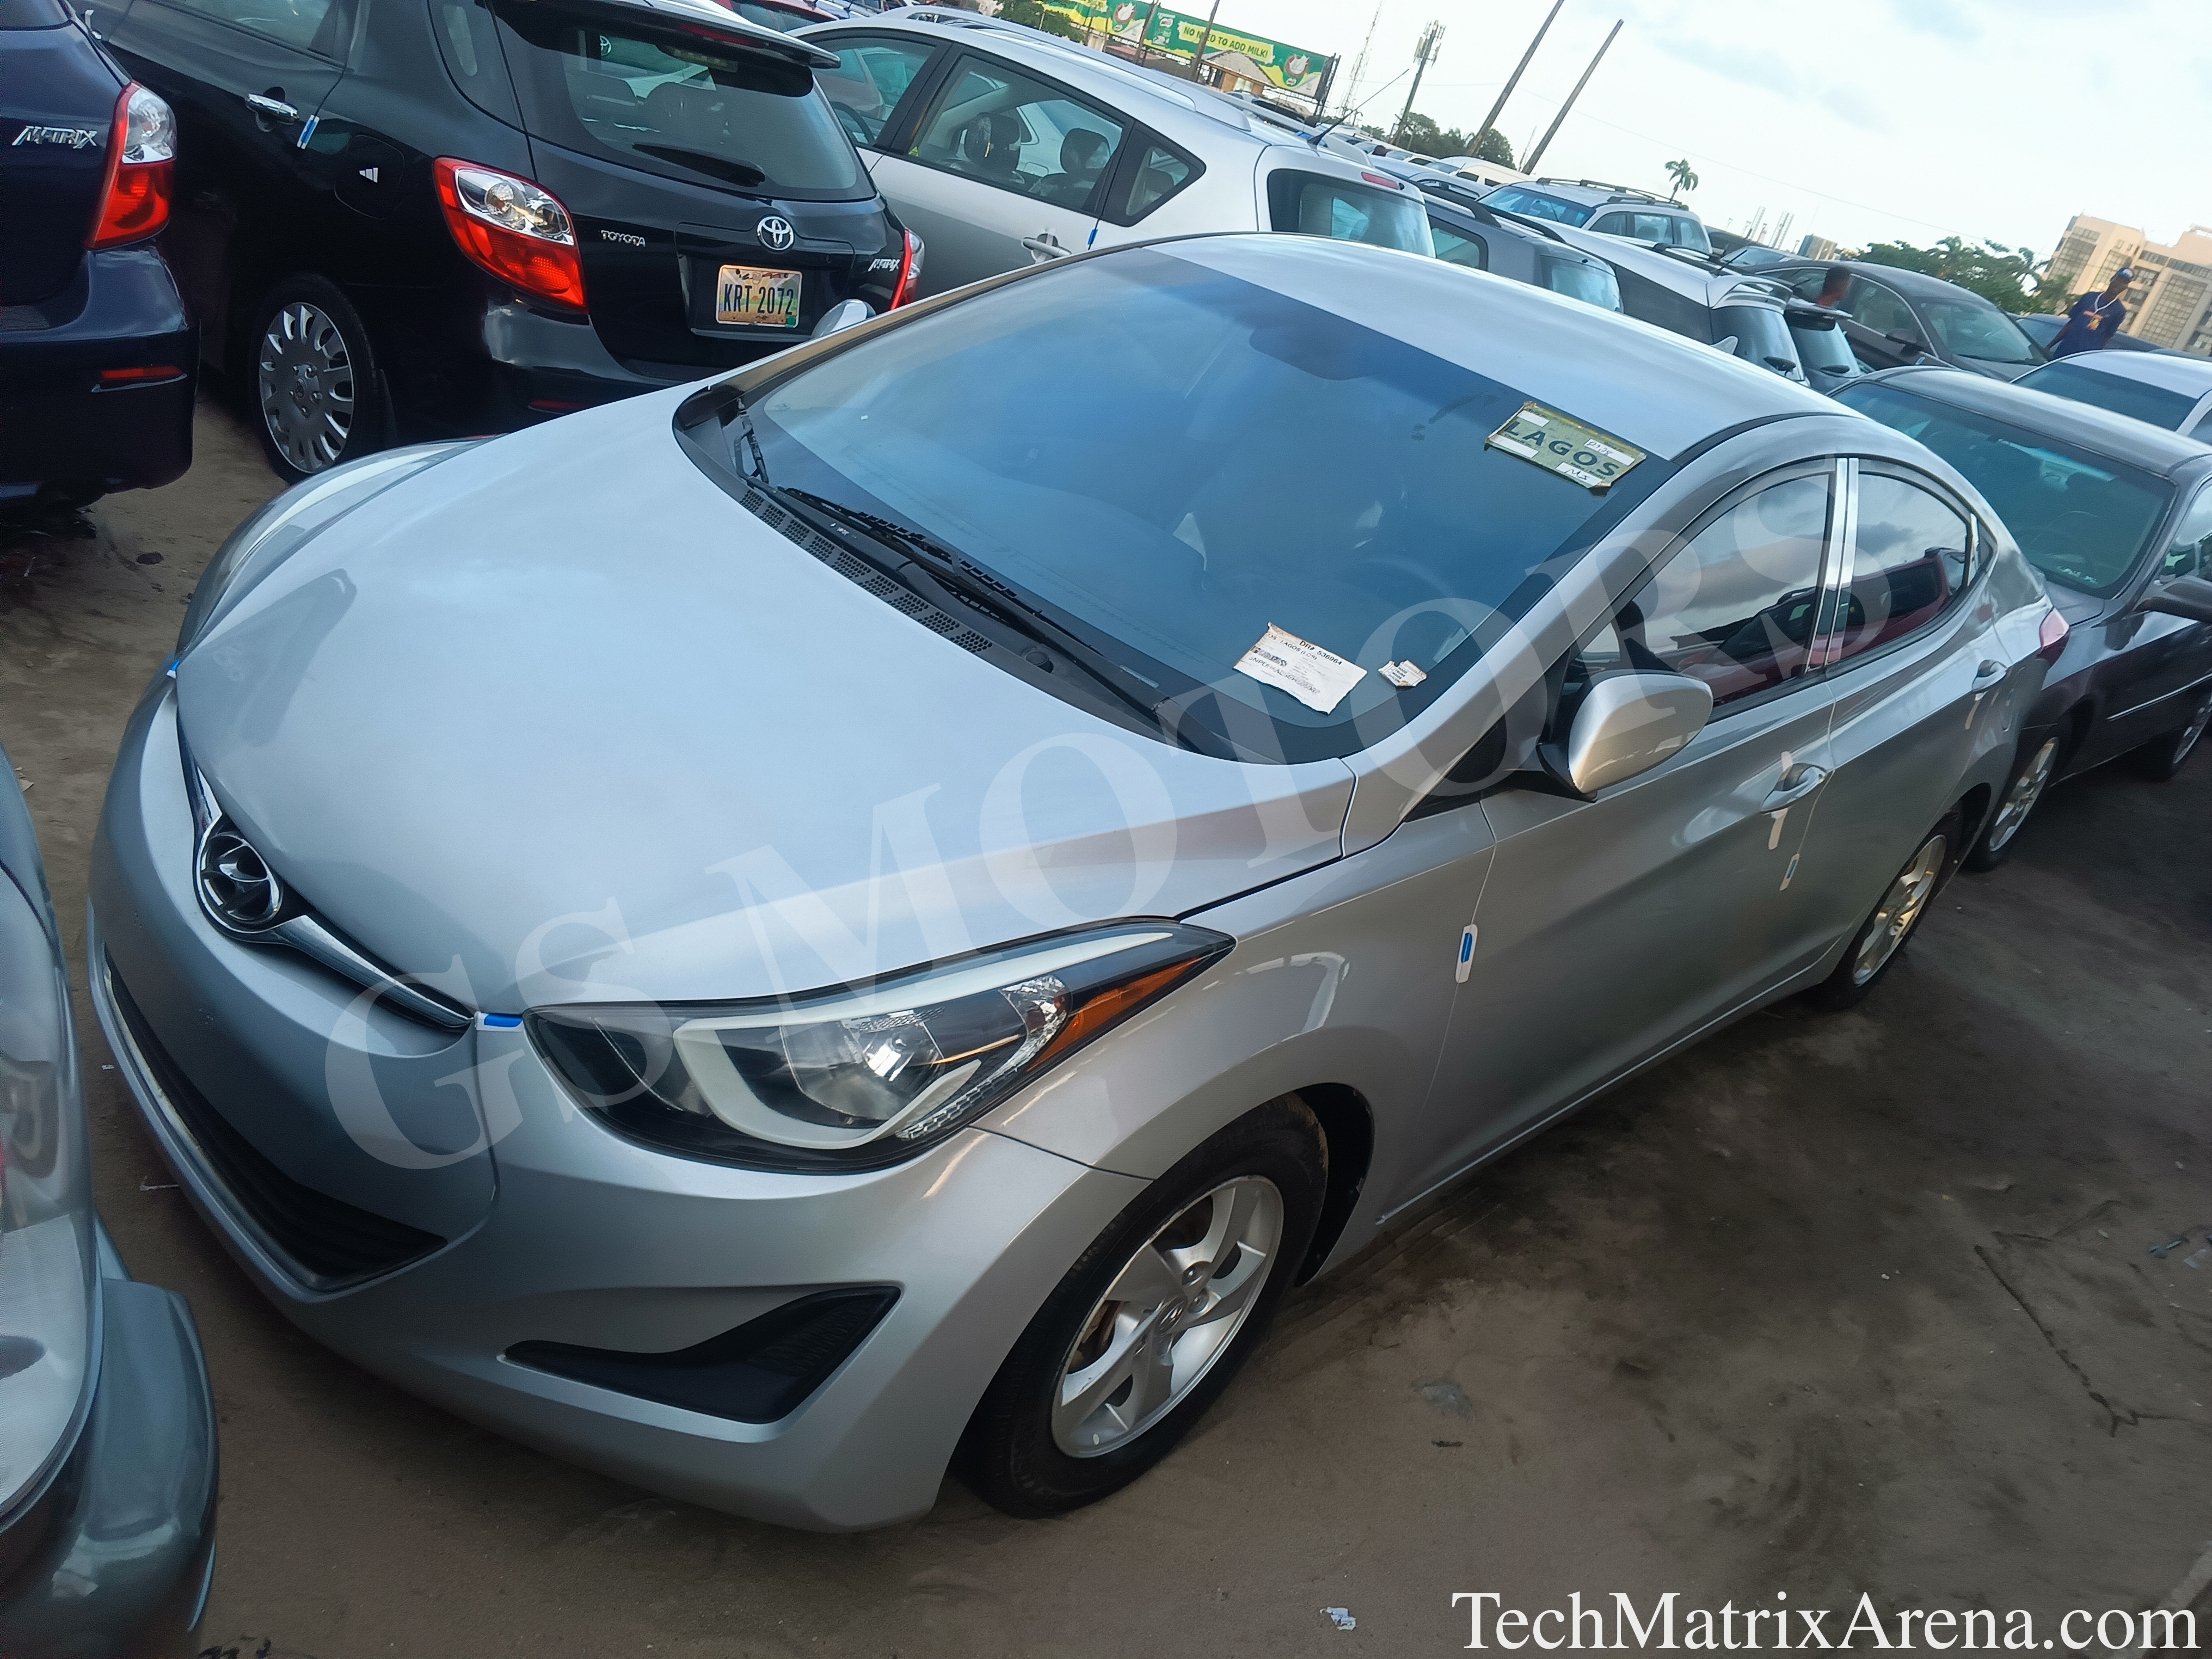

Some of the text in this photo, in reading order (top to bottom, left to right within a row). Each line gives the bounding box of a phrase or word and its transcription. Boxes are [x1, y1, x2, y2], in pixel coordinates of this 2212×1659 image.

[1183, 27, 1195, 36] NO
[1196, 31, 1215, 42] NED
[1219, 36, 1227, 46] TO
[1229, 40, 1246, 51] ADD
[1247, 45, 1268, 58] MILK!
[12, 125, 98, 149] MATRIX
[601, 230, 646, 247] TOYOTA
[724, 284, 794, 315] KRT 2072
[1504, 421, 1620, 476] LAGOS
[1280, 640, 1301, 653] LAGOS
[1317, 650, 1342, 665] 536964
